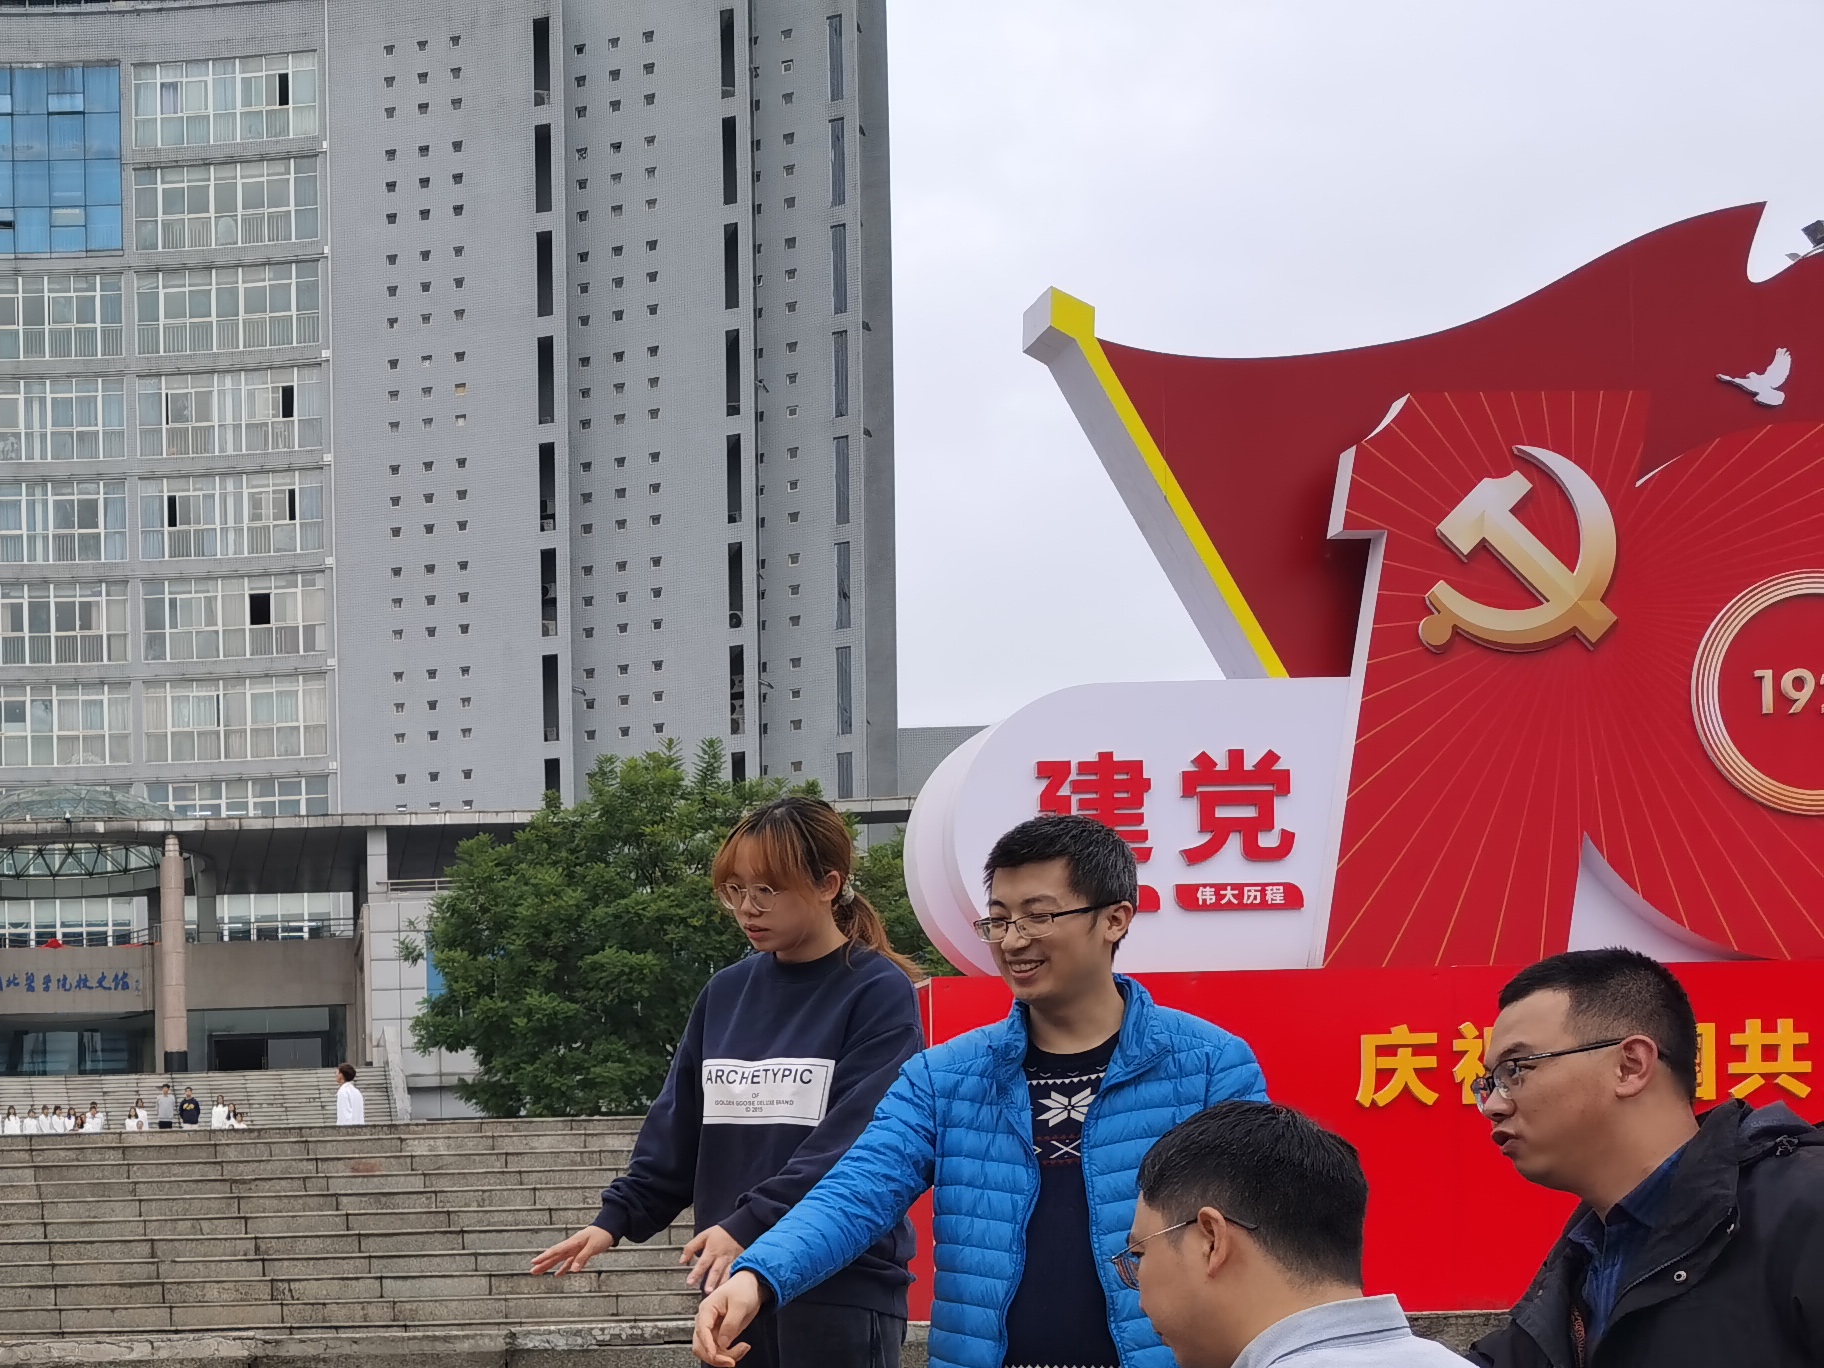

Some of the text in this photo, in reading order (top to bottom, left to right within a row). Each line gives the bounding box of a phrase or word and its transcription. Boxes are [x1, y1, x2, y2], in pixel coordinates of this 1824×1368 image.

[1196, 886, 1286, 906] 伟大历程
[705, 1068, 814, 1086] ARCHETYPIC
